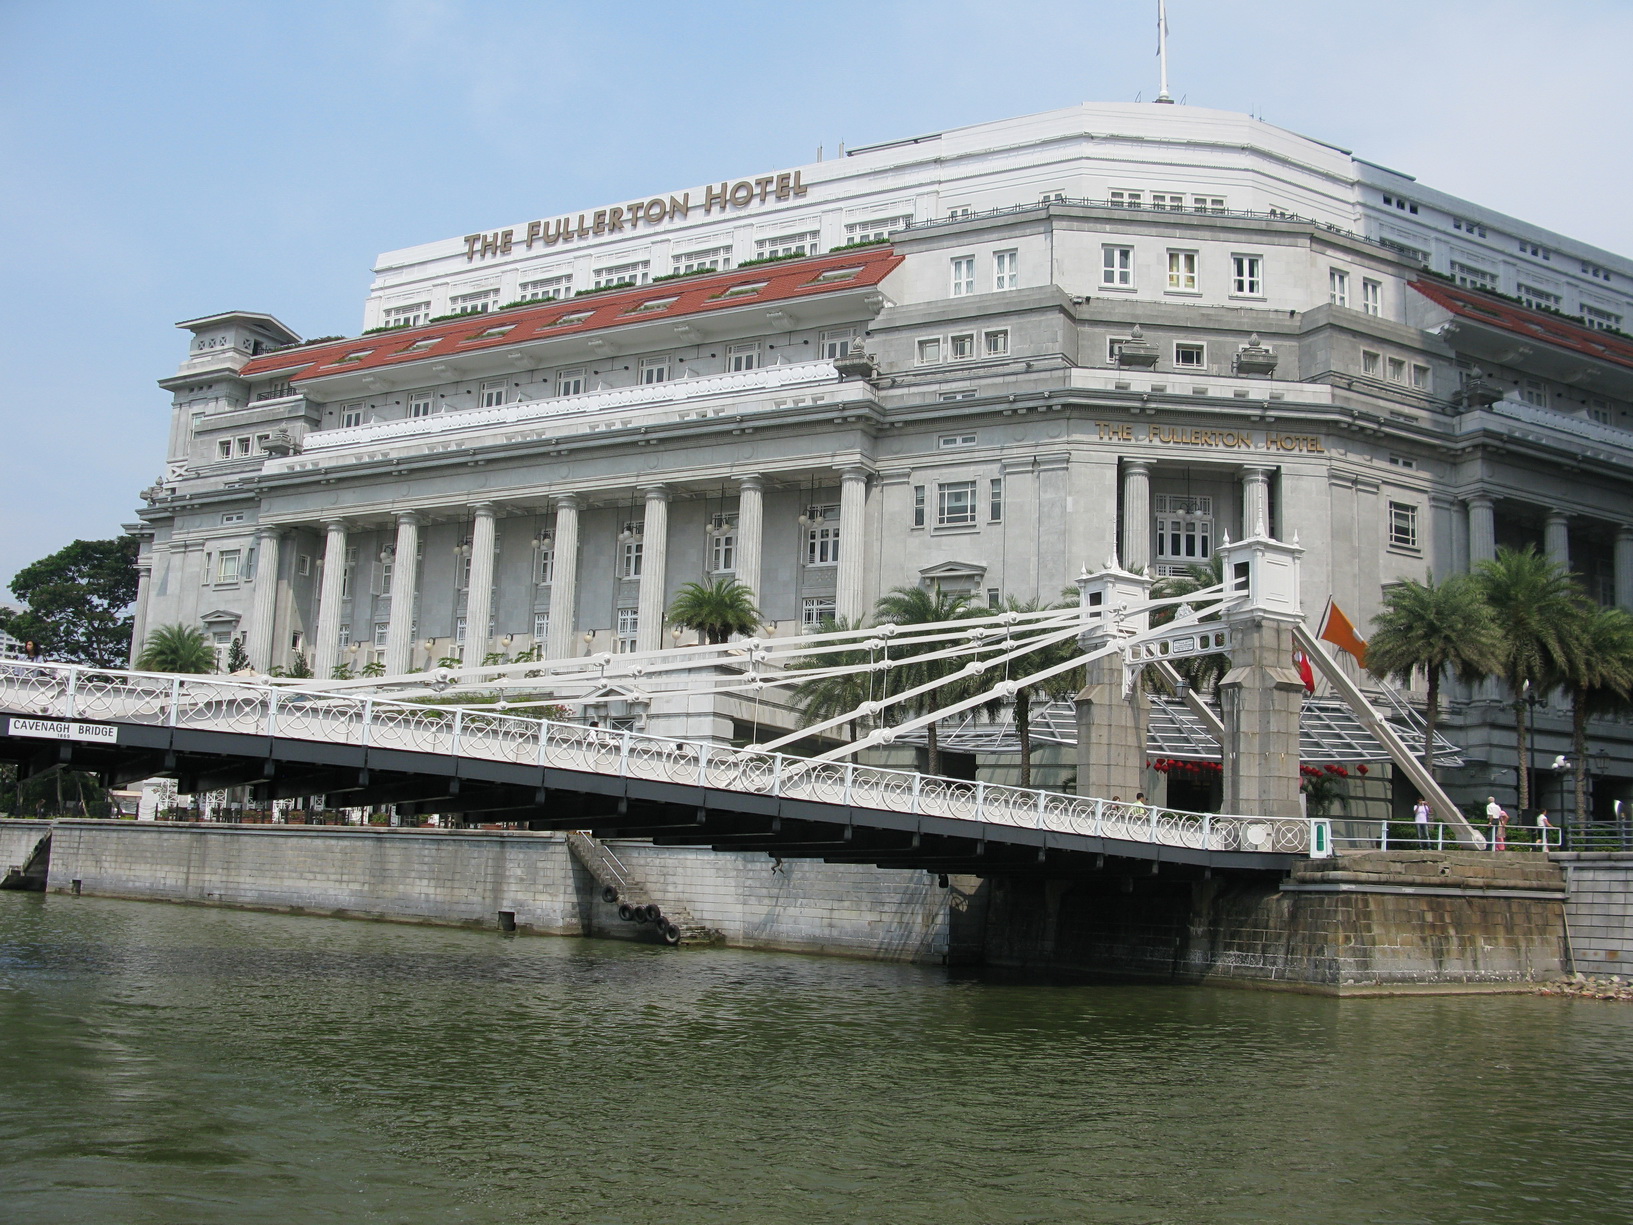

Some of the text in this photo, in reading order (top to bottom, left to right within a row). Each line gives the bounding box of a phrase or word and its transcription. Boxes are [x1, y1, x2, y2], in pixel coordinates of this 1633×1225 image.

[464, 170, 808, 259] THE FULLERTON HOTEL
[1095, 421, 1325, 452] THE FULLERTON HOTEL
[13, 720, 114, 737] CAVENAGH BRIDGE
